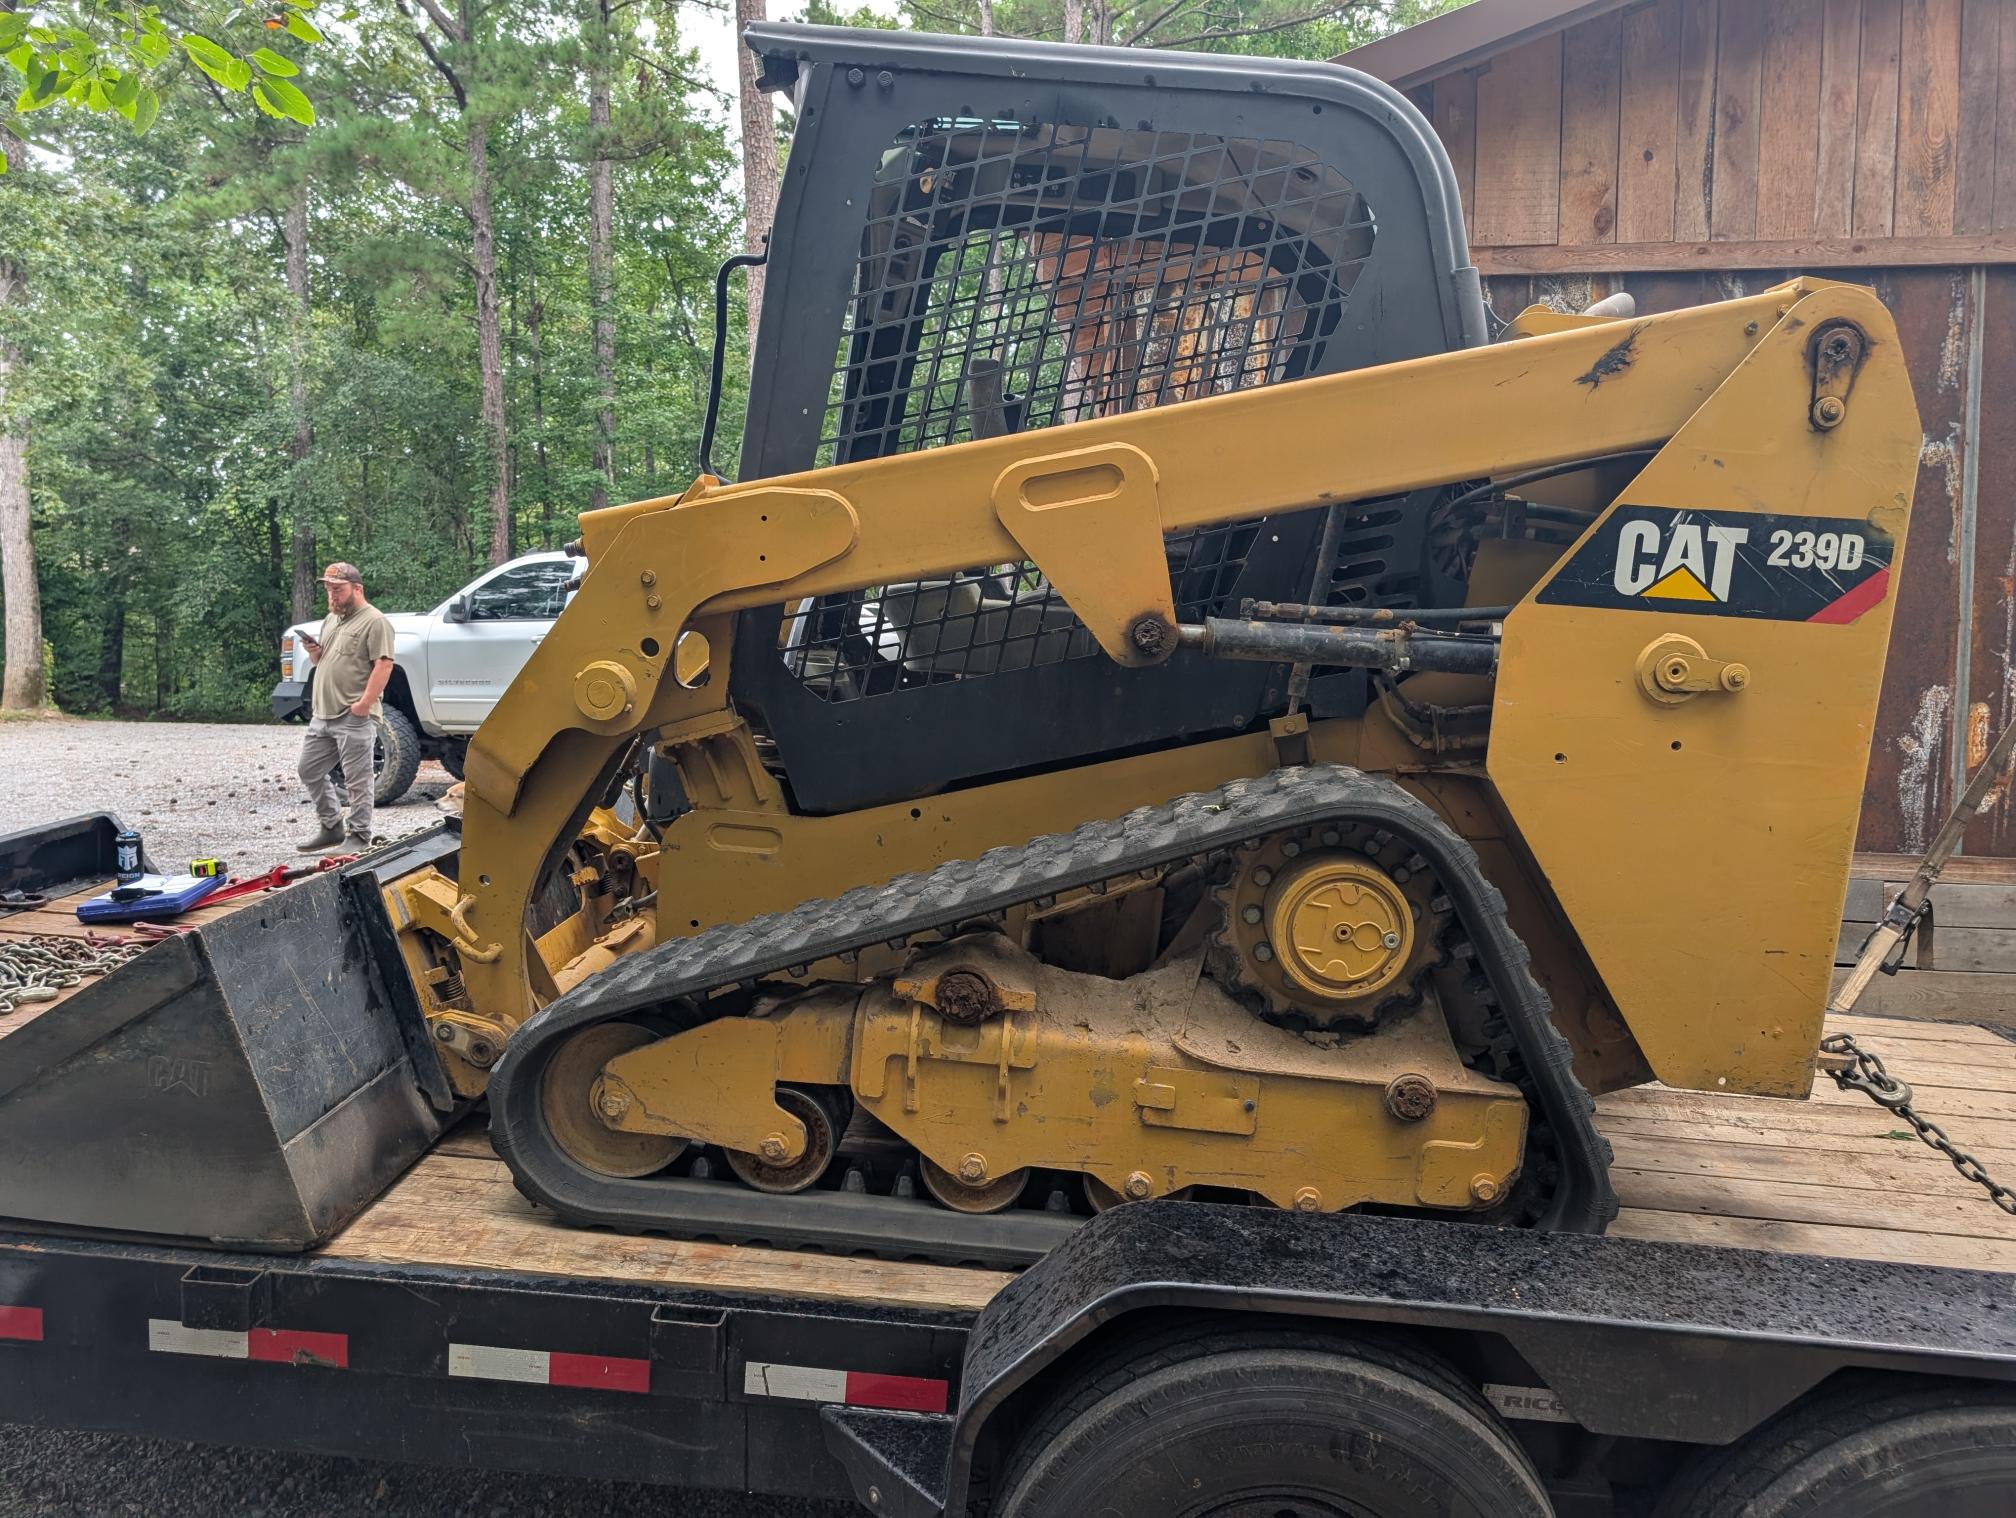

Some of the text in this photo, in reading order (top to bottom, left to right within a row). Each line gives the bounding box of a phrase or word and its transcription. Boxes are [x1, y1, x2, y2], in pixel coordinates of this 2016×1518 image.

[1613, 519, 1865, 603] CAT 239D
[145, 1055, 212, 1097] CAT
